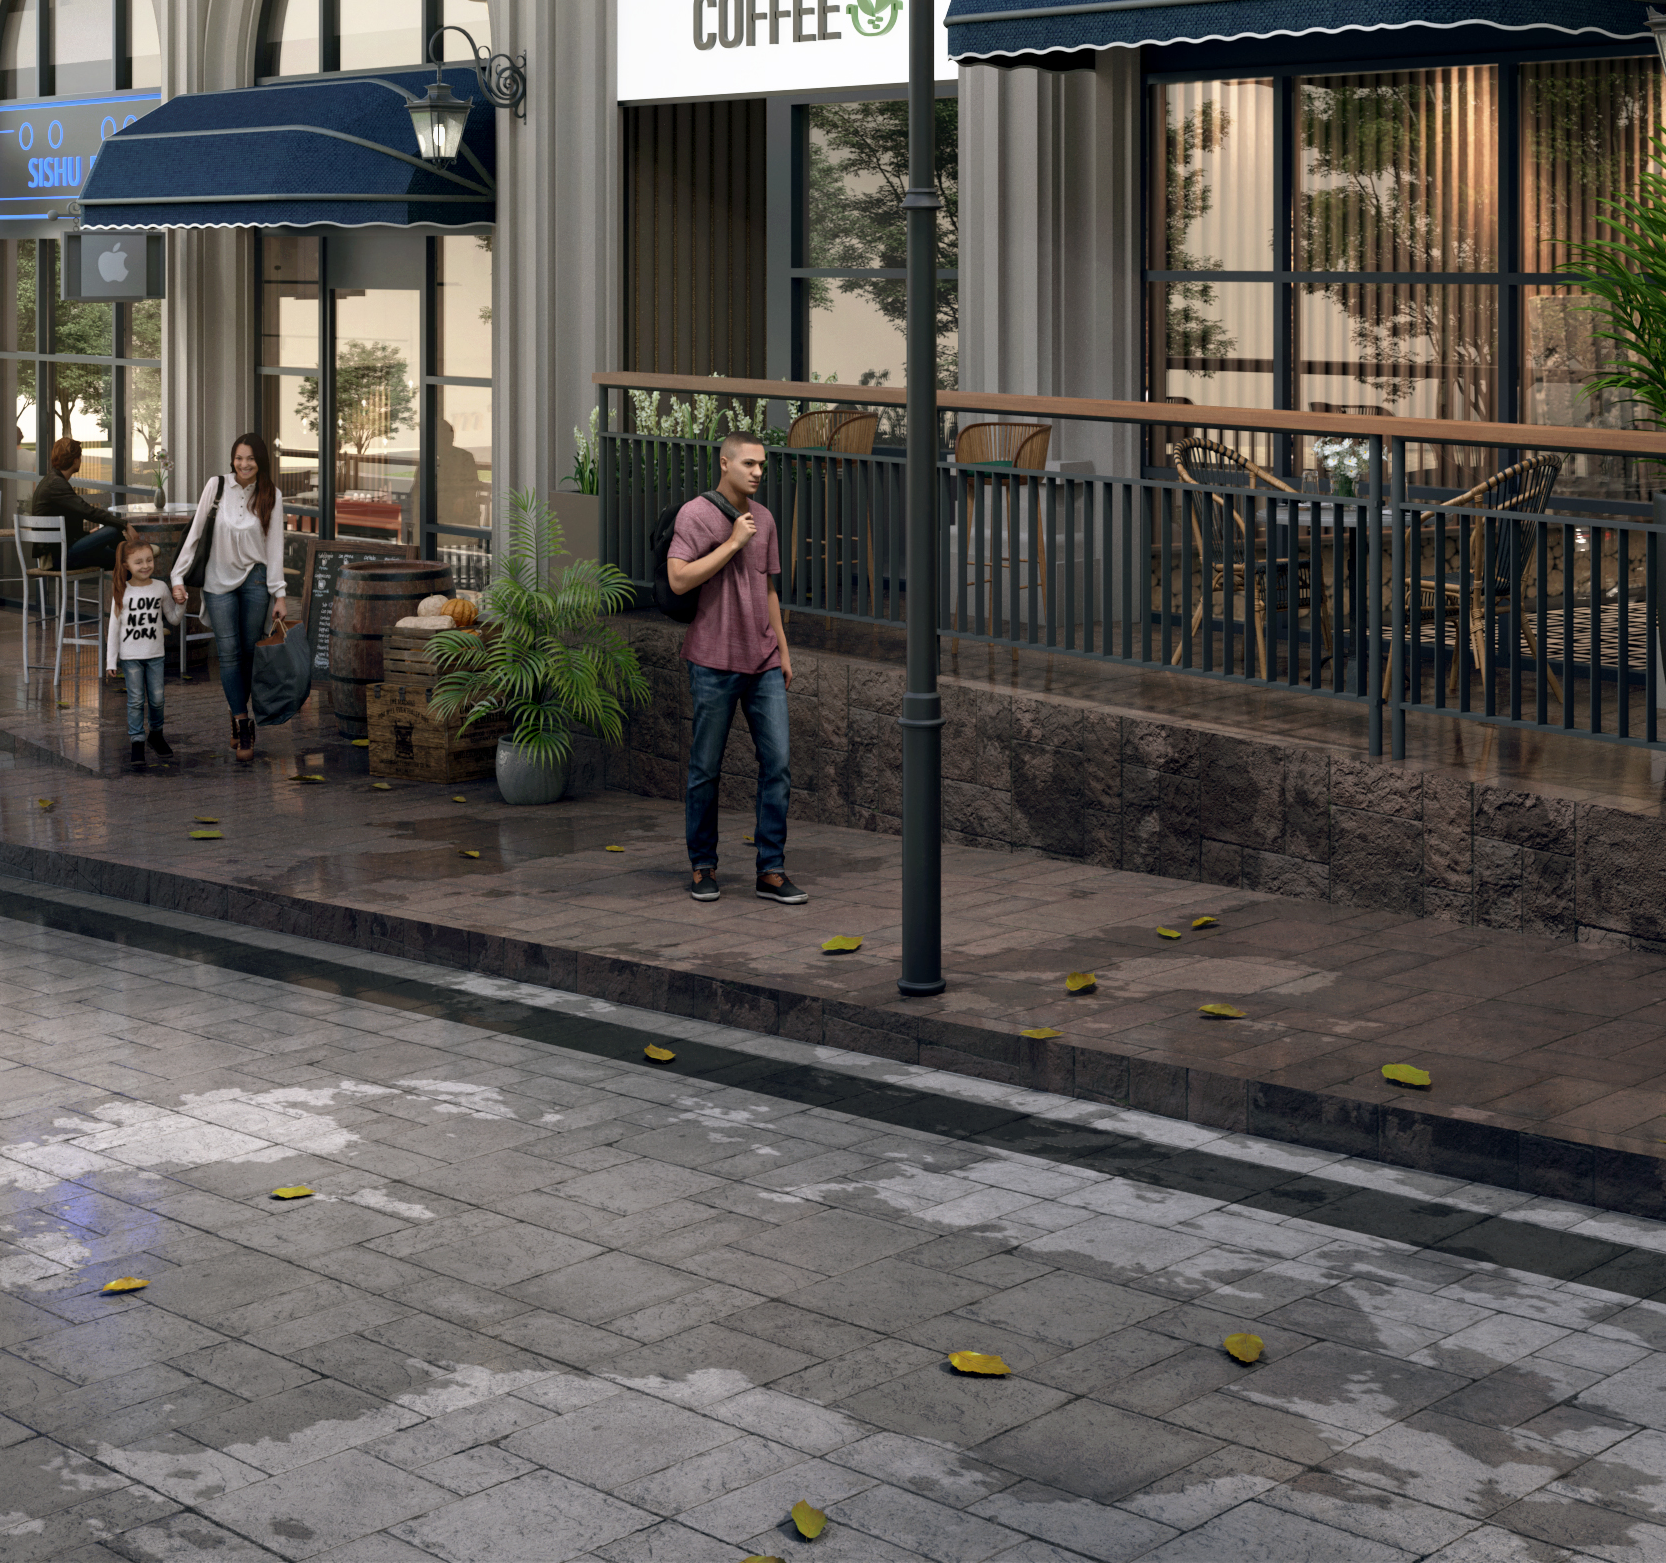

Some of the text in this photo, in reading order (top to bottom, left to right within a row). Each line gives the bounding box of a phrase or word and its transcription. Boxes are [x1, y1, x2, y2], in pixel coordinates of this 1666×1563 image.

[27, 155, 82, 189] SISHU
[128, 596, 162, 611] LOVE
[127, 612, 159, 627] NEW
[122, 626, 157, 643] YORK
